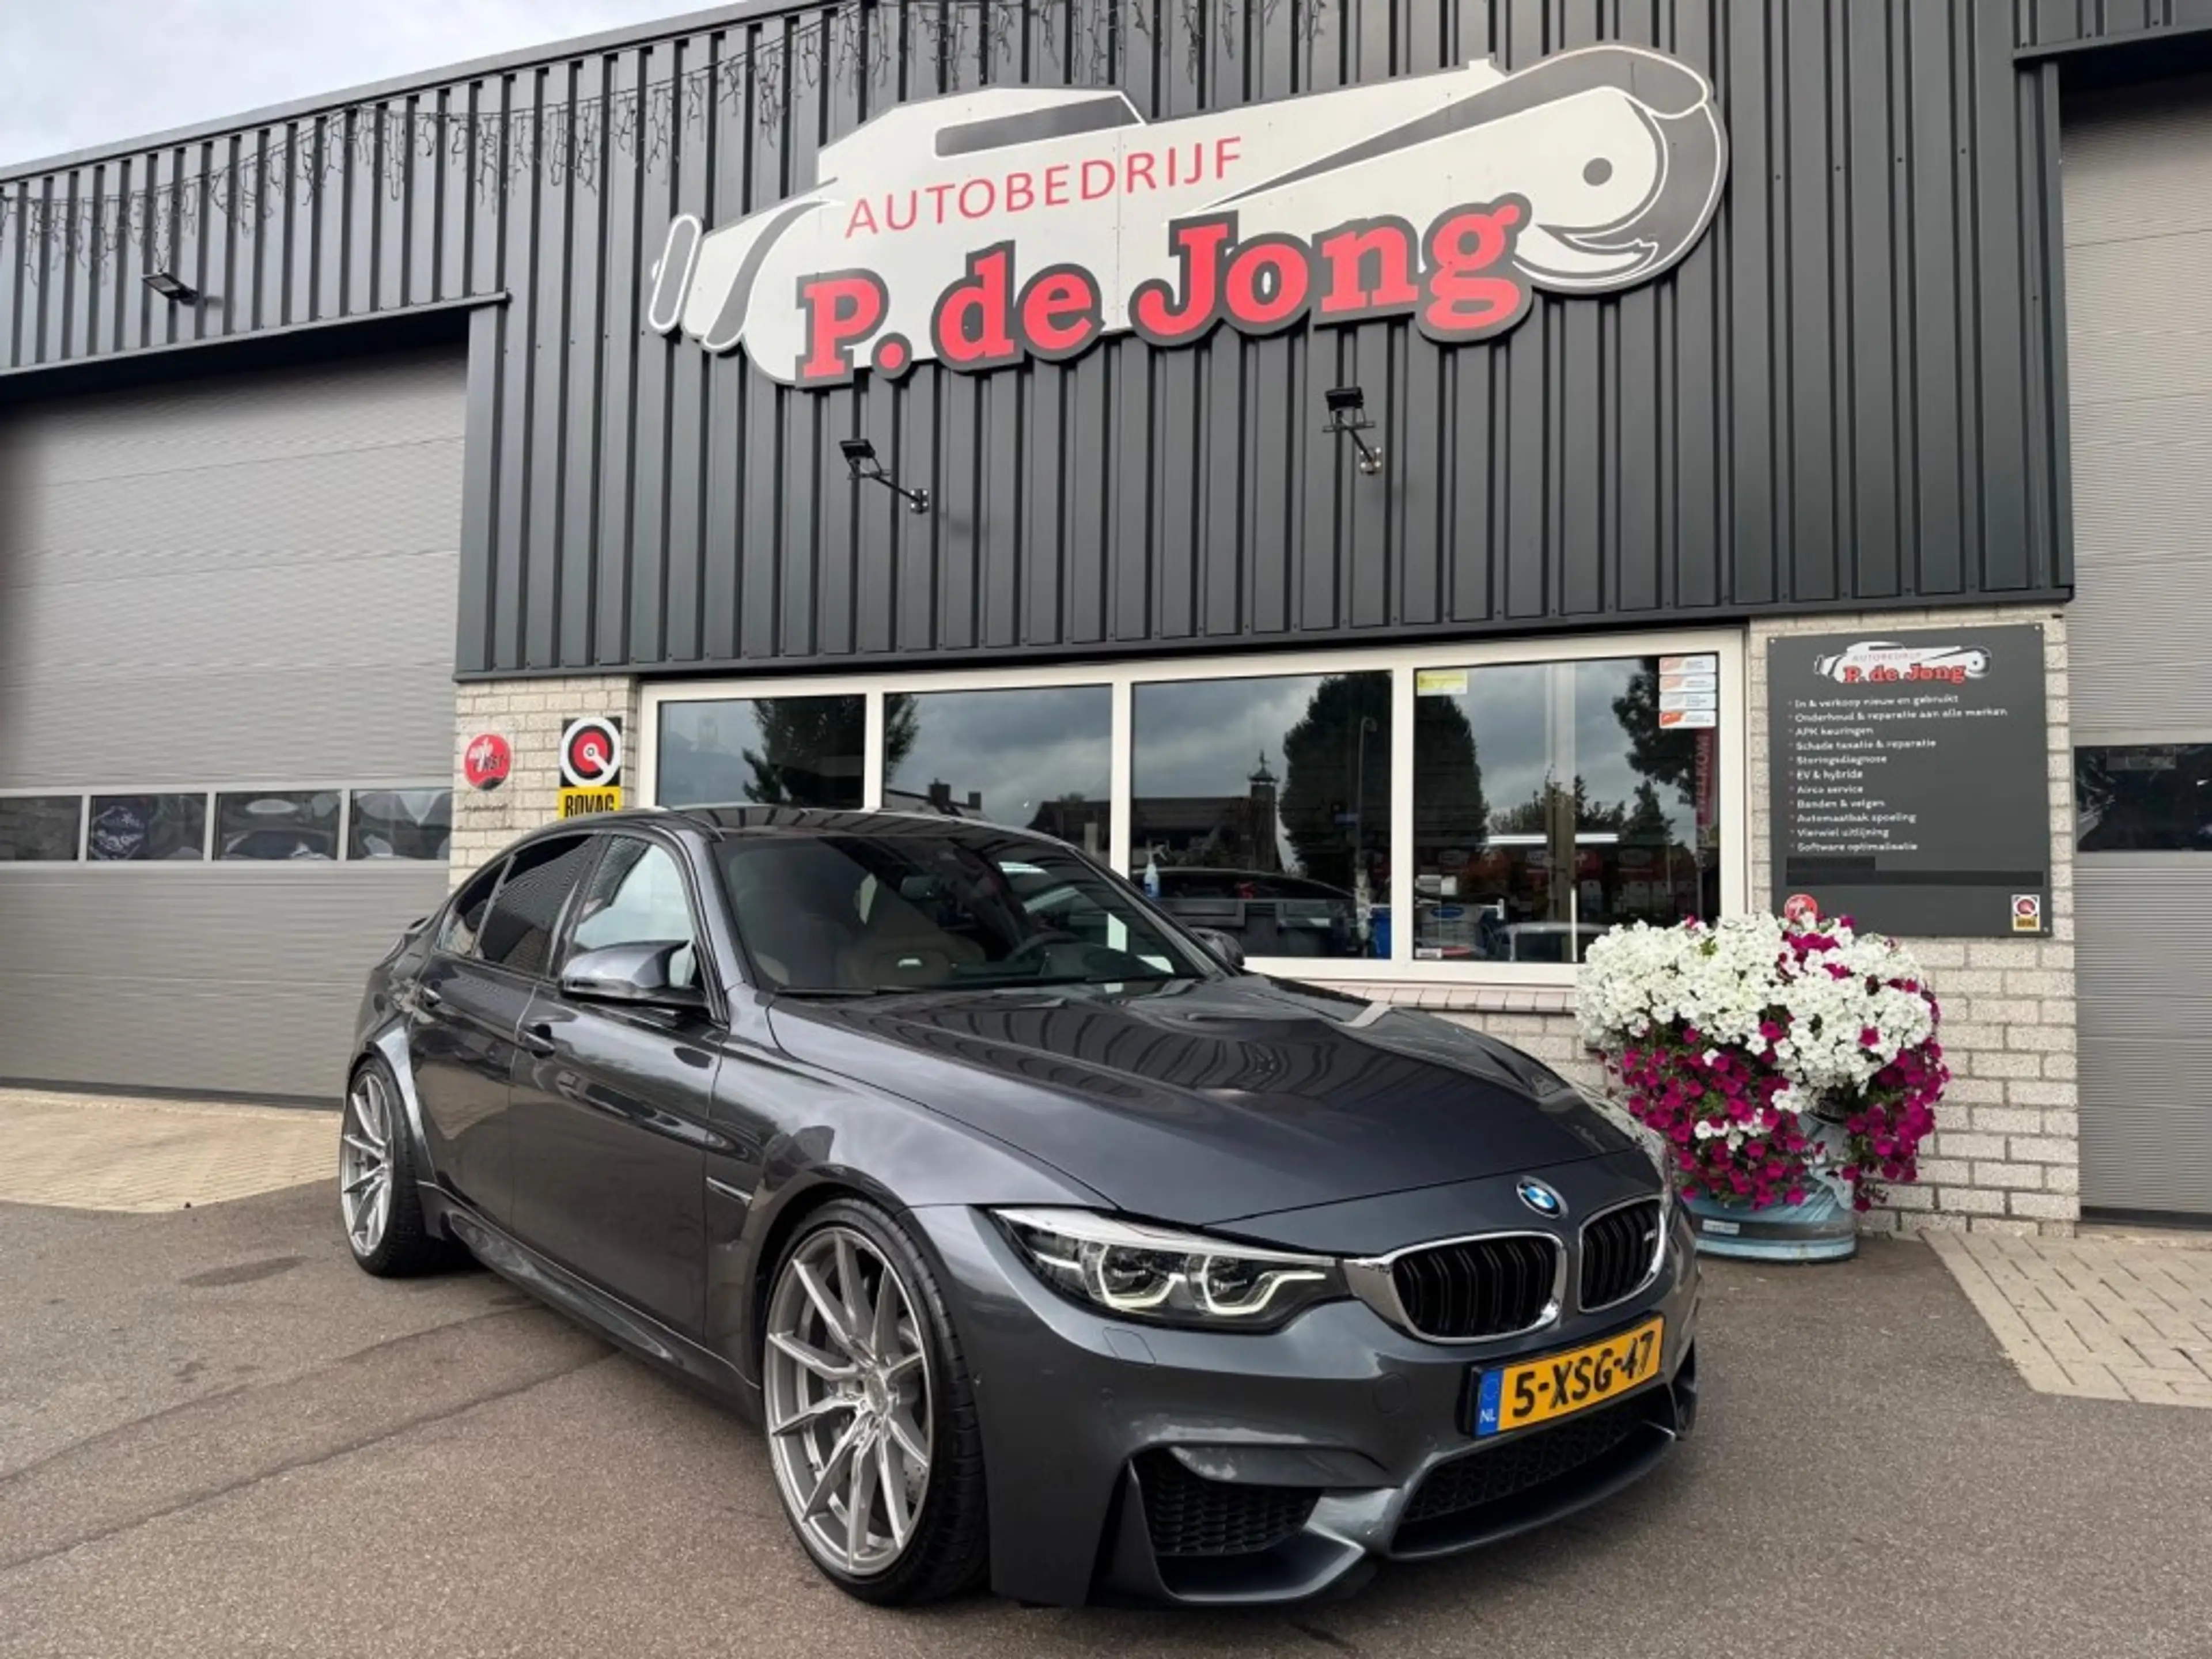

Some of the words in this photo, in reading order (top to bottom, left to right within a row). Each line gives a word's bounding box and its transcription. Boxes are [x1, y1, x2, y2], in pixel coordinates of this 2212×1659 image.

[846, 137, 1243, 238] AUTOBEDRIJF
[801, 274, 907, 380] P.
[934, 248, 1095, 365] de
[1135, 200, 1522, 336] Jong
[1843, 666, 1865, 683] P.
[1869, 665, 1898, 682] de
[1904, 663, 1966, 684] Jong
[1819, 698, 1861, 709] verkoop
[1863, 698, 1895, 706] nieuw
[1896, 697, 1910, 705] en
[1913, 694, 1959, 707] gebruikt
[1795, 712, 1854, 722] Onderhoud
[1857, 712, 1865, 720] &
[1867, 710, 1916, 721] reparatie
[1942, 707, 1962, 718] alle
[1795, 728, 1818, 736] APK
[1821, 726, 1873, 737] keuringen
[1796, 741, 1833, 751] Schade
[1836, 740, 1873, 749] taxatie
[1876, 740, 1884, 748] &
[1886, 737, 1937, 749] reparatie
[1796, 755, 1887, 766] Storingsdiagnose
[1797, 770, 1810, 780] EV
[1813, 770, 1821, 778] &
[1823, 769, 1863, 782] hybride
[1797, 786, 1825, 794] Airco
[1827, 785, 1863, 793] service
[1797, 799, 1837, 809] Banden
[1840, 799, 1848, 808] &
[1850, 798, 1885, 809] velgen
[1797, 813, 1869, 823] Automaatbak
[1871, 812, 1917, 824] spoeling
[1797, 827, 1839, 836] Vierwiel
[1841, 827, 1889, 839] uitlijning
[1797, 842, 1845, 852] Software
[1847, 841, 1918, 854] optimalisatie
[1512, 1330, 1656, 1418] 5-XSG-47
[1479, 1408, 1497, 1425] NL
